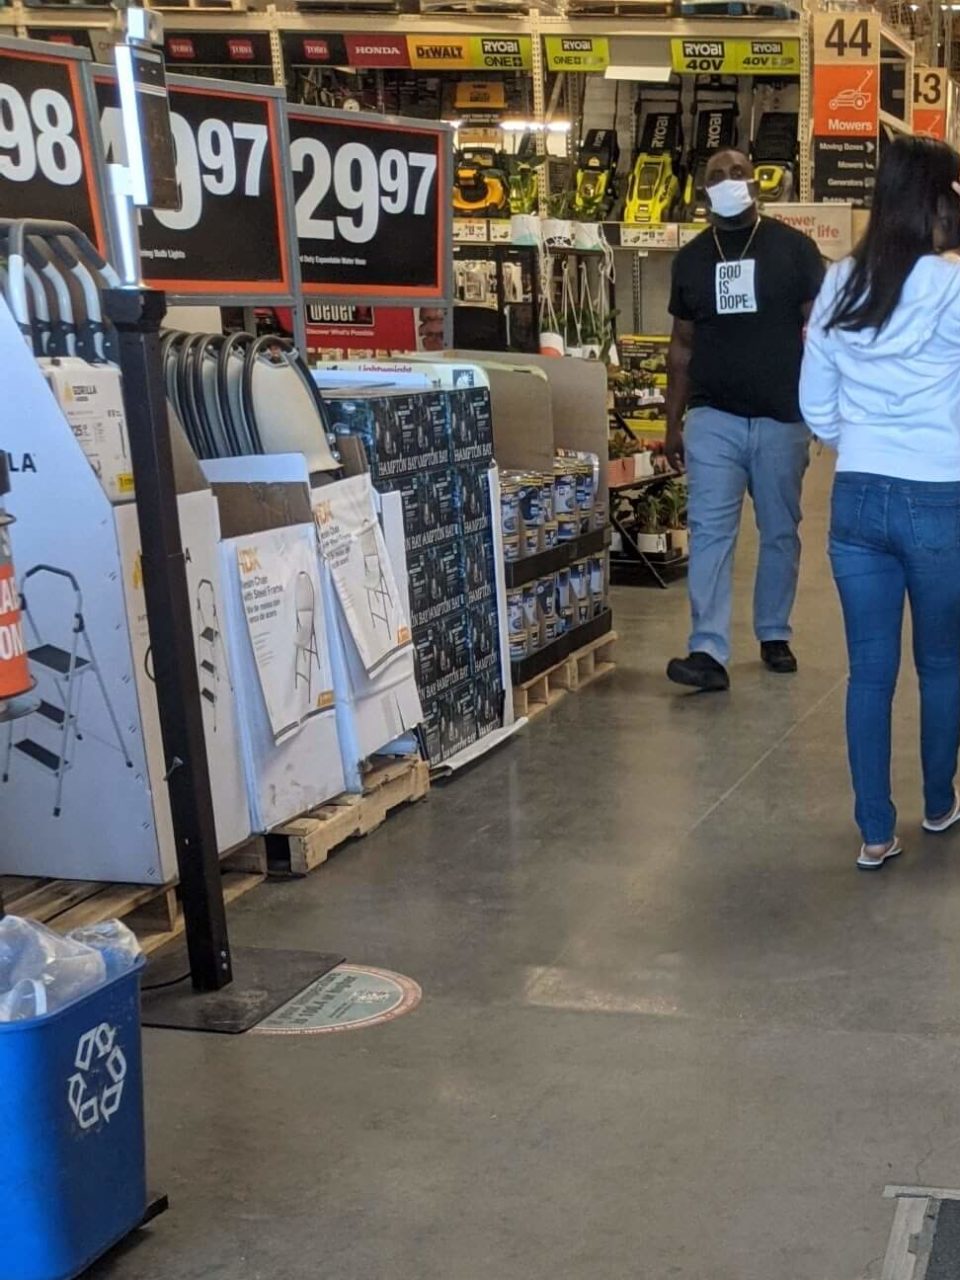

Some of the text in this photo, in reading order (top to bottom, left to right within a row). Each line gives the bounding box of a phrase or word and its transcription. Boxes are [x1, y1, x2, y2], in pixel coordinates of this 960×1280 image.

[824, 19, 872, 57] 44
[355, 46, 401, 55] HONDA
[483, 40, 519, 53] RYOBI
[562, 40, 592, 51] RYOBI
[684, 42, 723, 56] RYOBI
[752, 43, 782, 53] RYOBI
[685, 59, 724, 71] 40V
[742, 56, 769, 66] 40V
[651, 115, 670, 149] RYOBI
[706, 112, 723, 148] RYOBI
[828, 118, 873, 132] Mowers
[819, 142, 846, 152] Moving
[817, 225, 840, 239] life
[718, 264, 742, 280] GOD
[718, 280, 730, 295] IS
